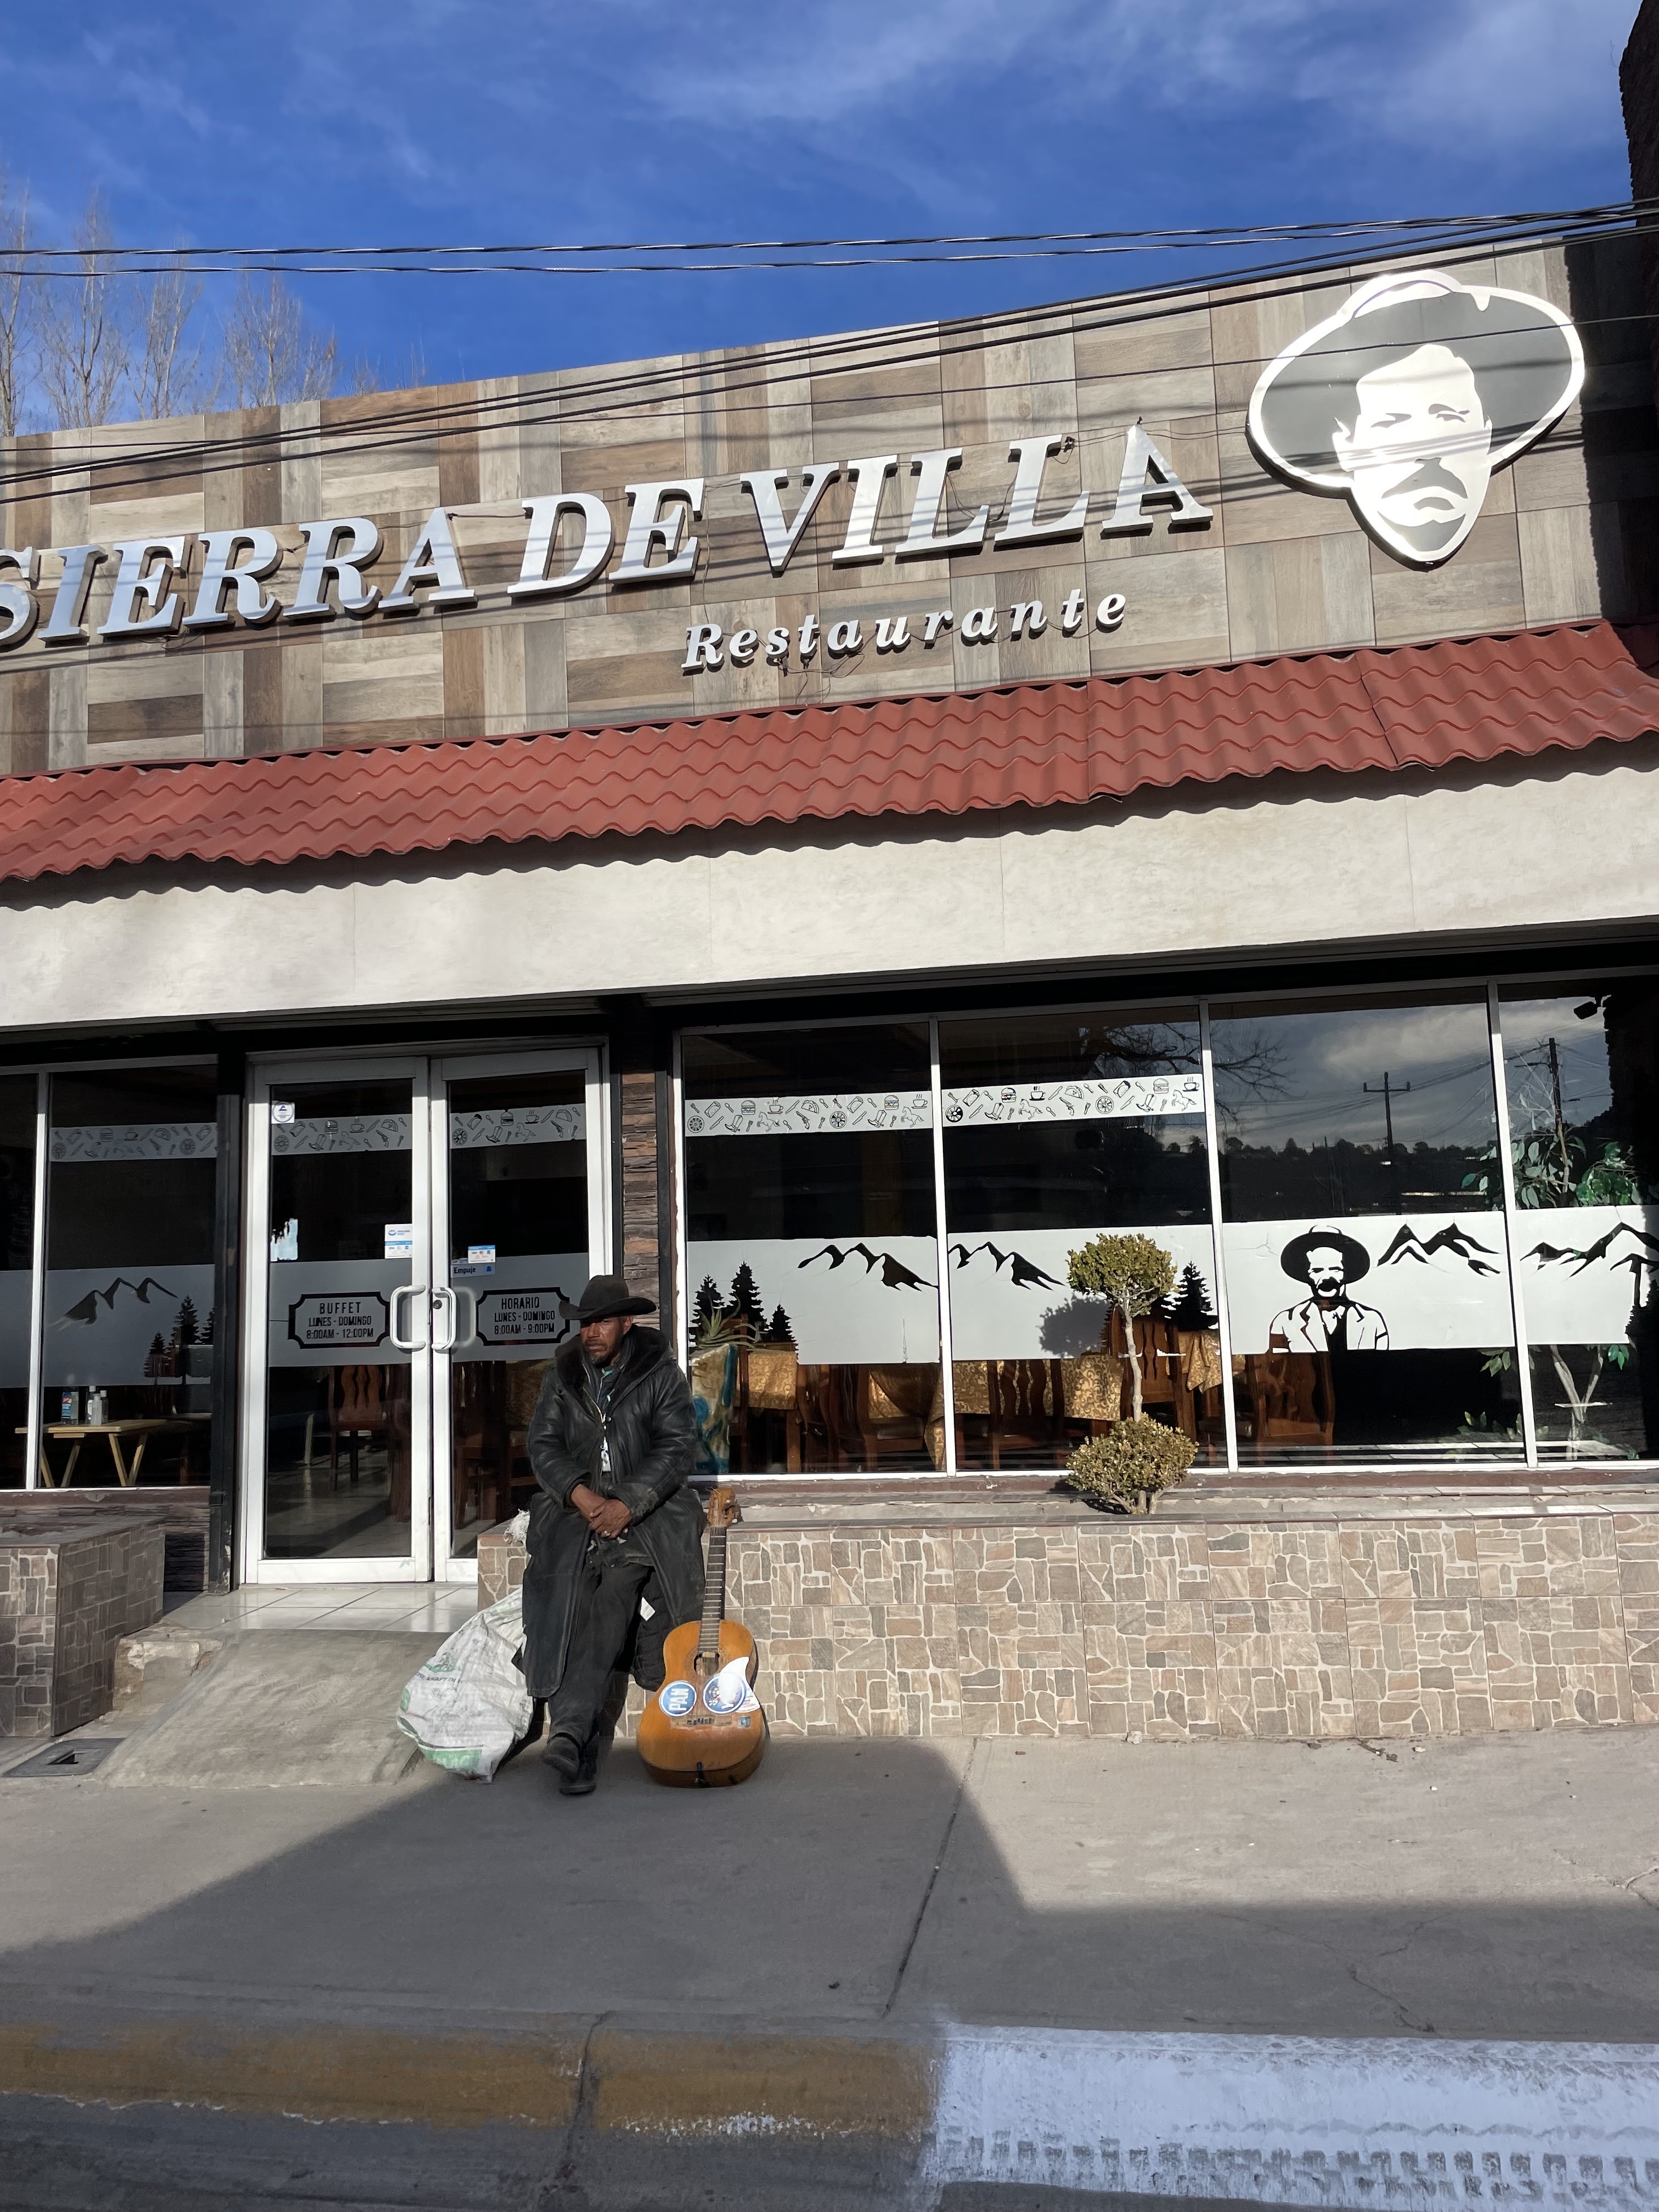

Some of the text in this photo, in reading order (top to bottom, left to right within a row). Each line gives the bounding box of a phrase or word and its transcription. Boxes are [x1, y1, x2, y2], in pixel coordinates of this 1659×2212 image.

[0, 425, 1214, 645] SIERRA DE VILLA
[681, 589, 1126, 670] Restaurante
[454, 1266, 476, 1274] Empuje
[319, 1302, 361, 1314] BUFFET
[501, 1297, 540, 1310] HORARIO
[308, 1317, 331, 1327] LUNES
[338, 1316, 371, 1325] DOMINGO
[494, 1312, 516, 1322] LUNES
[523, 1310, 555, 1321] DOMINGO
[306, 1329, 334, 1339] 8:00AM
[342, 1328, 374, 1338] 12:00PM
[494, 1324, 521, 1335] 8:00AM
[528, 1323, 555, 1333] 9:00PM
[669, 1688, 689, 1711] PAN
